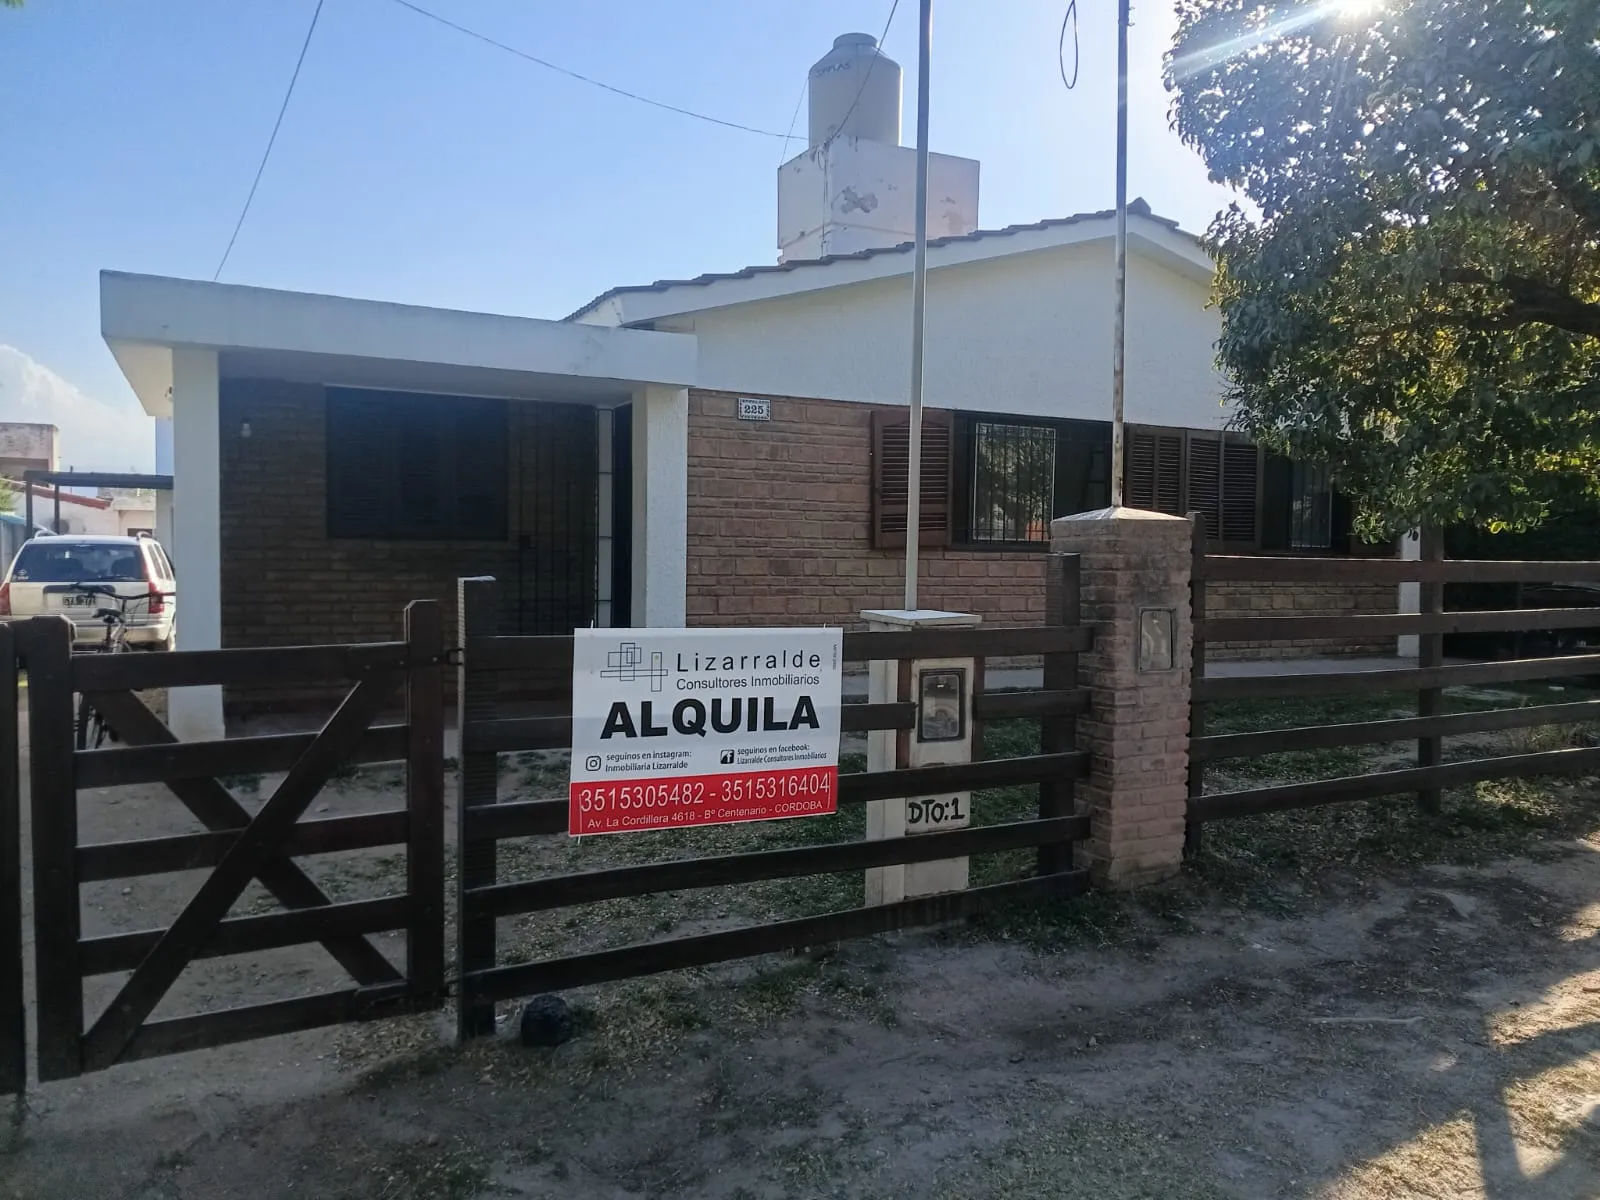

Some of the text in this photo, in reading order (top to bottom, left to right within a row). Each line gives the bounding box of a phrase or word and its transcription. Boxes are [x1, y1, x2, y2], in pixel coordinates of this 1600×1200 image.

[744, 404, 764, 415] 225
[677, 649, 820, 672] Lizarralde
[676, 673, 820, 690] Consultores Inmobiliarios
[600, 695, 820, 739] ALQUILA
[606, 752, 640, 762] seguinos
[652, 750, 692, 760] instagram:
[737, 746, 767, 756] seguinos
[778, 744, 810, 752] facebook:
[605, 760, 689, 772] Inmobiliaria Lizarralde
[581, 782, 704, 812] 3515305482
[721, 772, 830, 802] 3515316404
[606, 818, 619, 827] La
[622, 814, 669, 826] Cordillera
[672, 811, 696, 821] 4618
[718, 808, 766, 818] Centenario
[775, 800, 822, 813] CORDOBA
